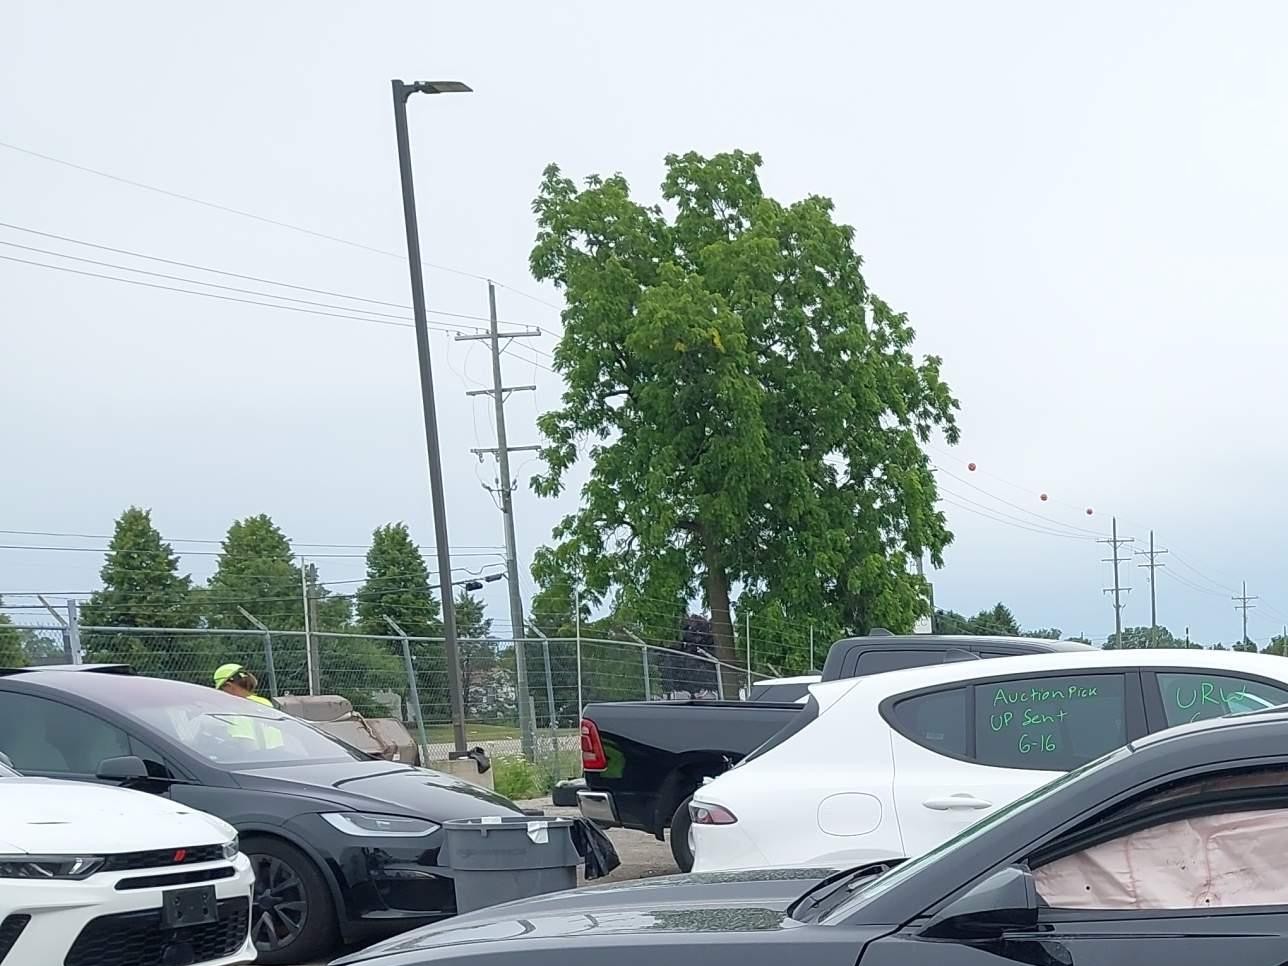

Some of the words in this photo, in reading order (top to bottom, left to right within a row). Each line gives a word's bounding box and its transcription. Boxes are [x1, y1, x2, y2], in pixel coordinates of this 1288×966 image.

[993, 688, 1065, 707] Auction
[1022, 708, 1068, 726] Sent
[1019, 734, 1056, 753] 6-16
